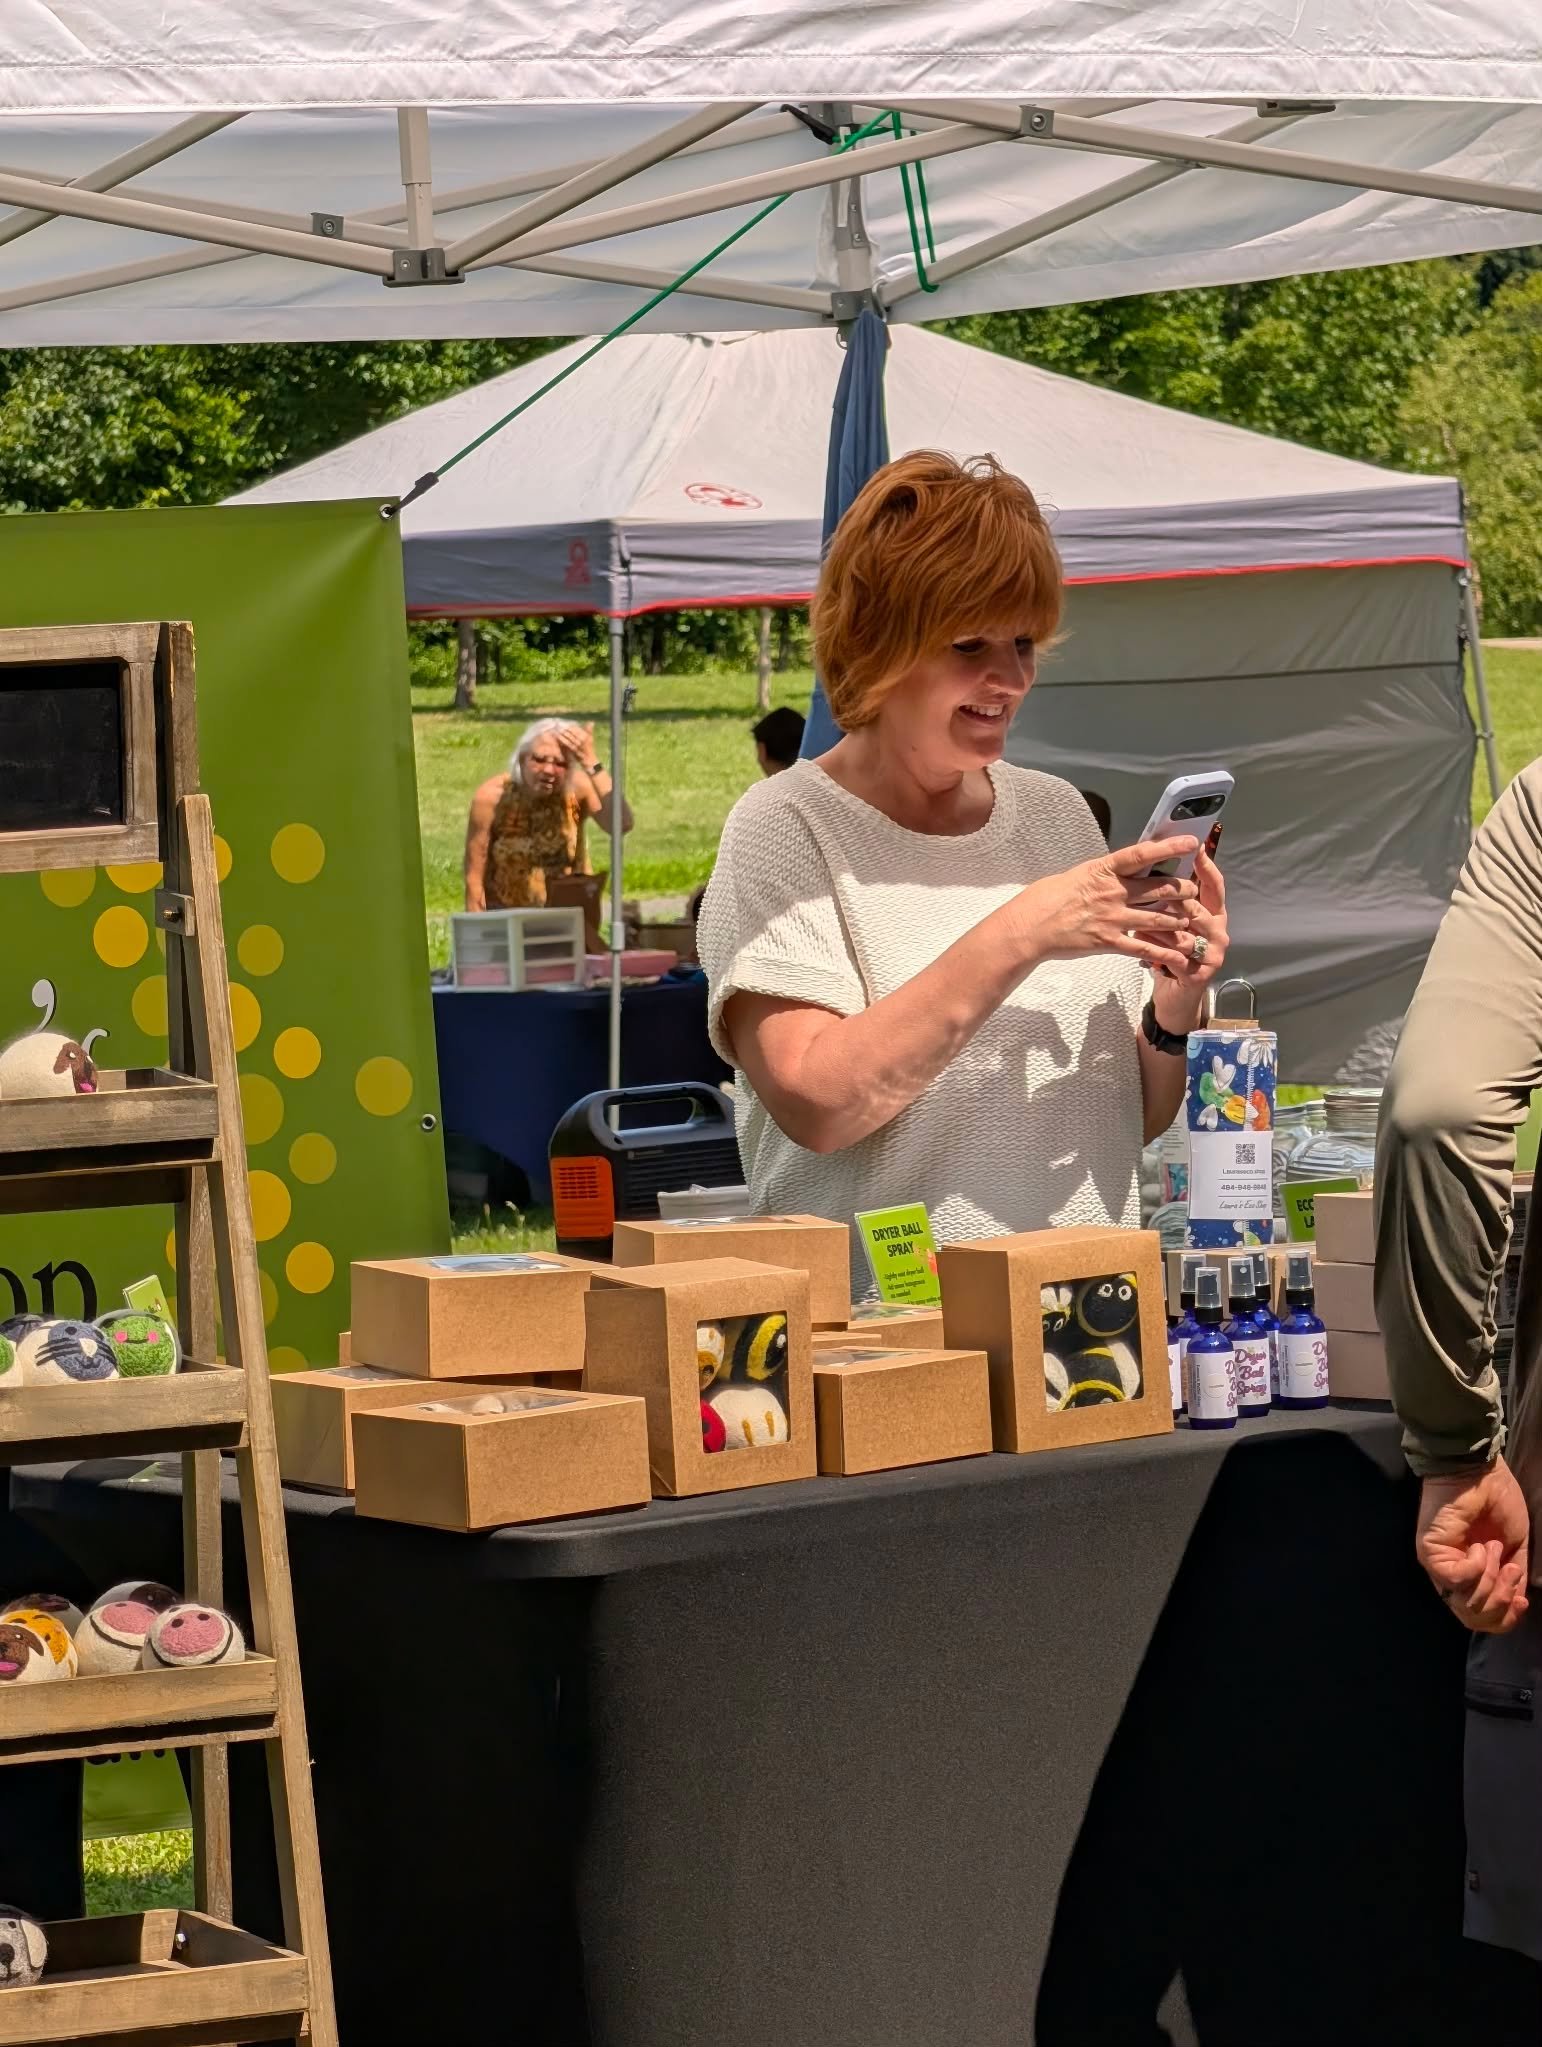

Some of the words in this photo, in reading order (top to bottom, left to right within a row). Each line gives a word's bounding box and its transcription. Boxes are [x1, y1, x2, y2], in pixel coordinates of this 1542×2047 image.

[872, 1226, 901, 1241] DRYER
[901, 1222, 923, 1236] BALL
[887, 1241, 914, 1257] SPRAY
[1235, 1348, 1266, 1365] Dryer
[1237, 1381, 1267, 1397] Spray
